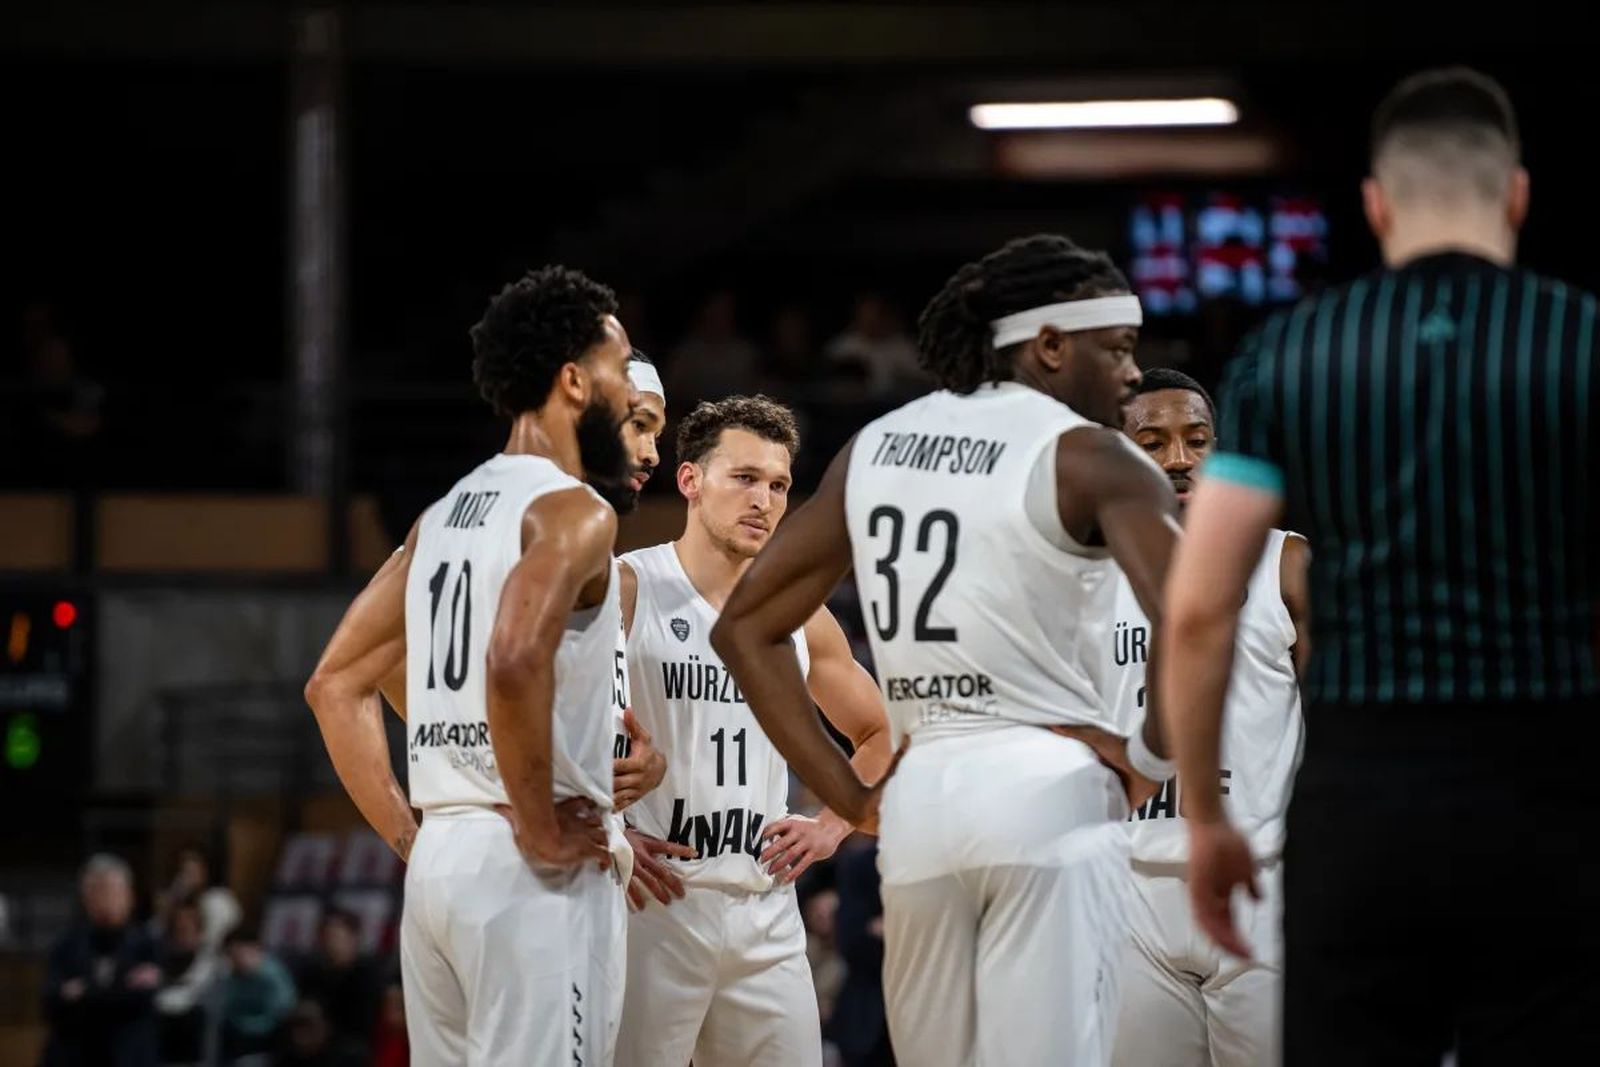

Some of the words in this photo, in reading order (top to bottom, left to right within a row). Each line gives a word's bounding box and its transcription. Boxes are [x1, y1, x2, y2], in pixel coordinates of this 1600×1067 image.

[871, 432, 1006, 475] THOMPSON
[868, 505, 959, 642] 32
[427, 559, 471, 691] 10
[710, 727, 747, 787] 11
